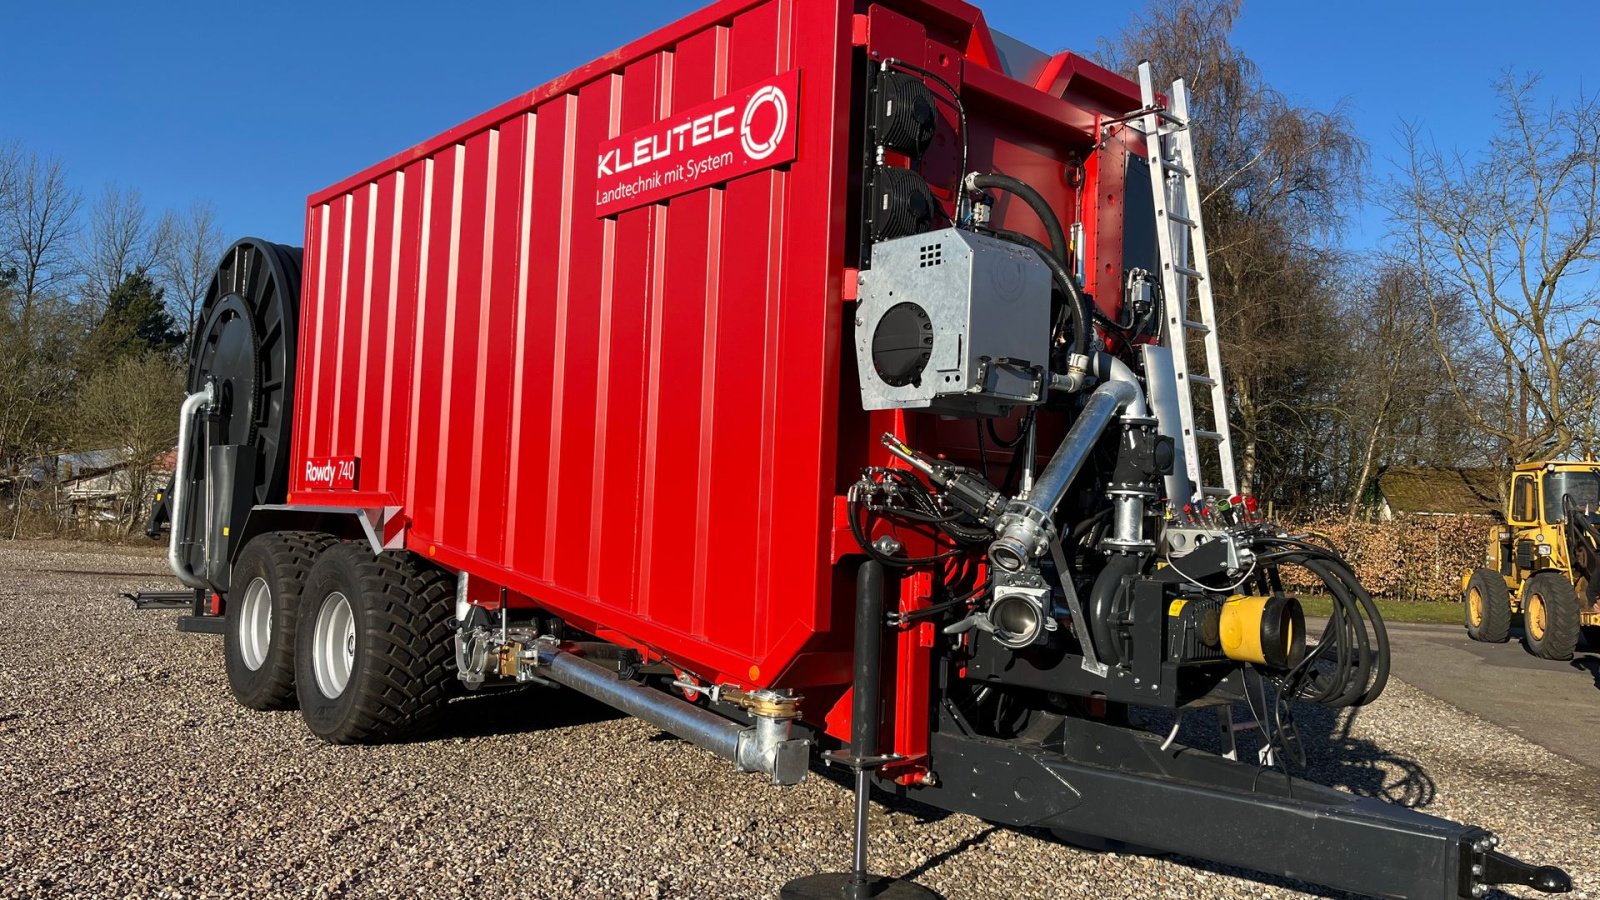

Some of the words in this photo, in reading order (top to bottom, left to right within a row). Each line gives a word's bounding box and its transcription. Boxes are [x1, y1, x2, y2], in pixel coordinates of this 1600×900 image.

[597, 105, 736, 180] KLEUTEC
[595, 170, 662, 206] Landtechnik
[664, 164, 684, 184] mit
[686, 150, 734, 180] System
[305, 459, 336, 487] Rowdy
[338, 460, 355, 480] 740
